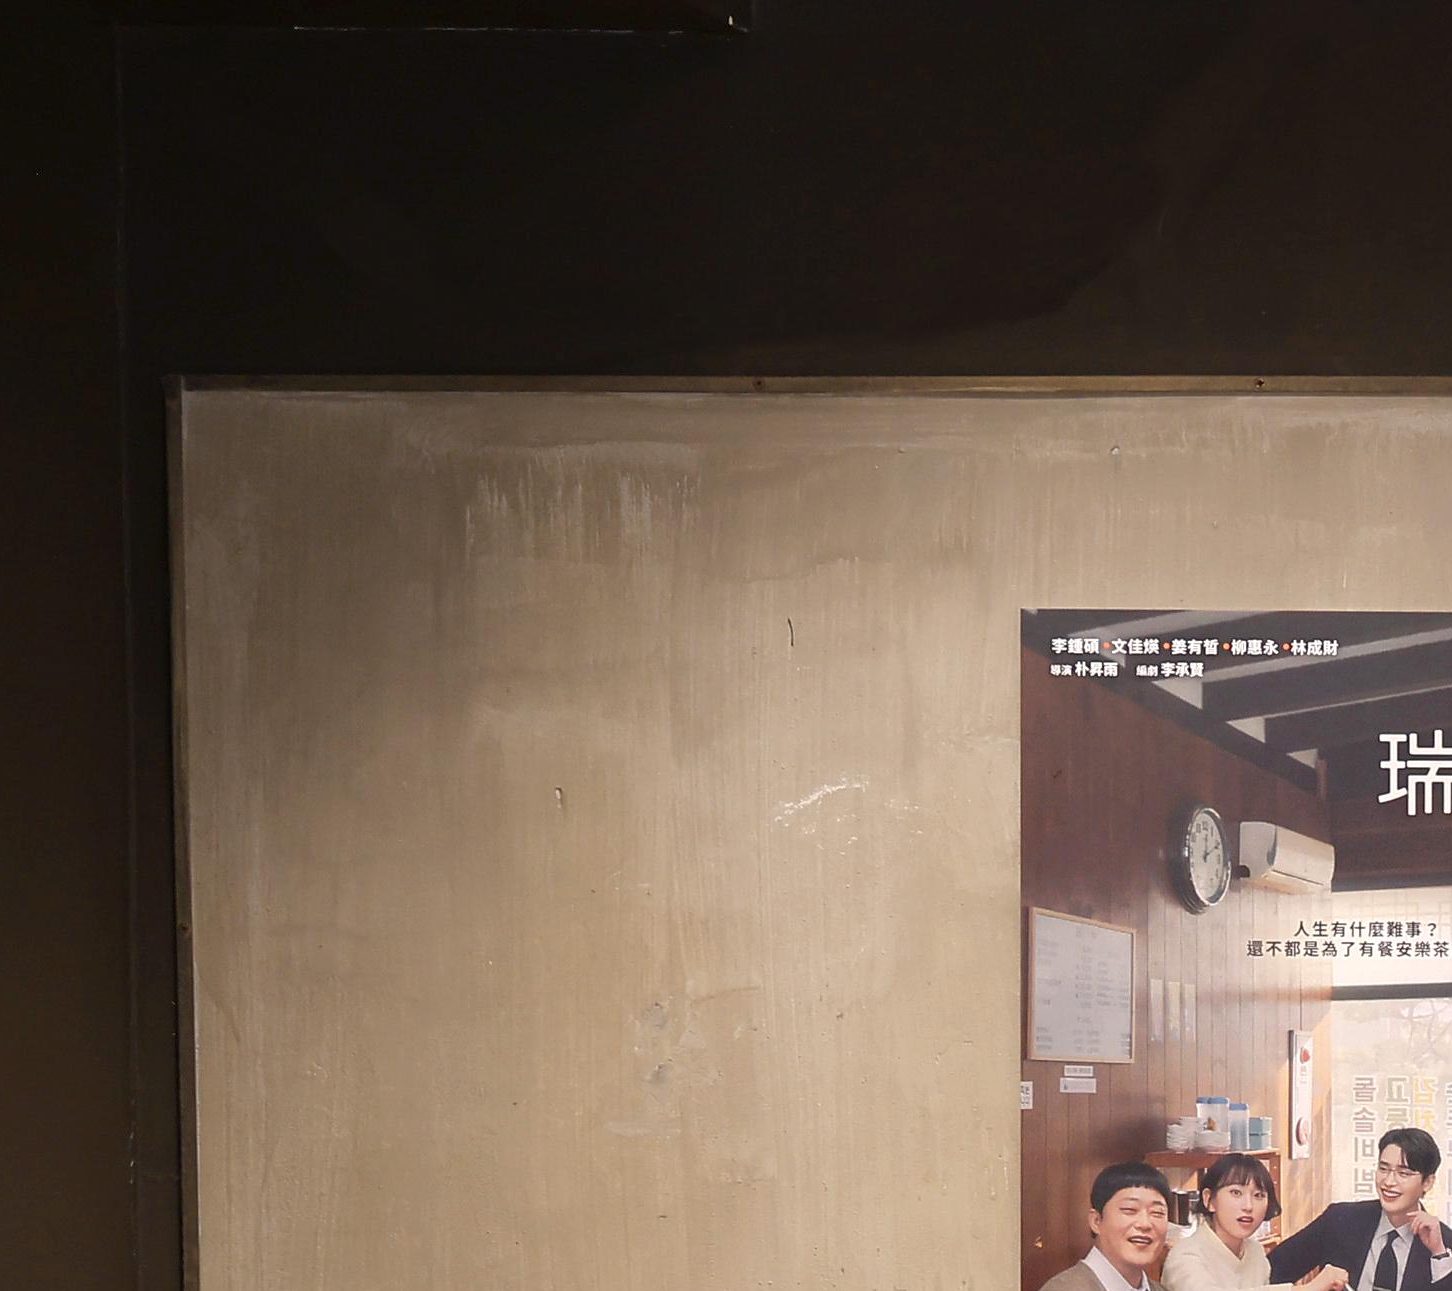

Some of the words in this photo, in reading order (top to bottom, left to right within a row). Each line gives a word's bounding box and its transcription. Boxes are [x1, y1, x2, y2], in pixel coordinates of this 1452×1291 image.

[1294, 921, 1437, 937] 人生有什麼難事？
